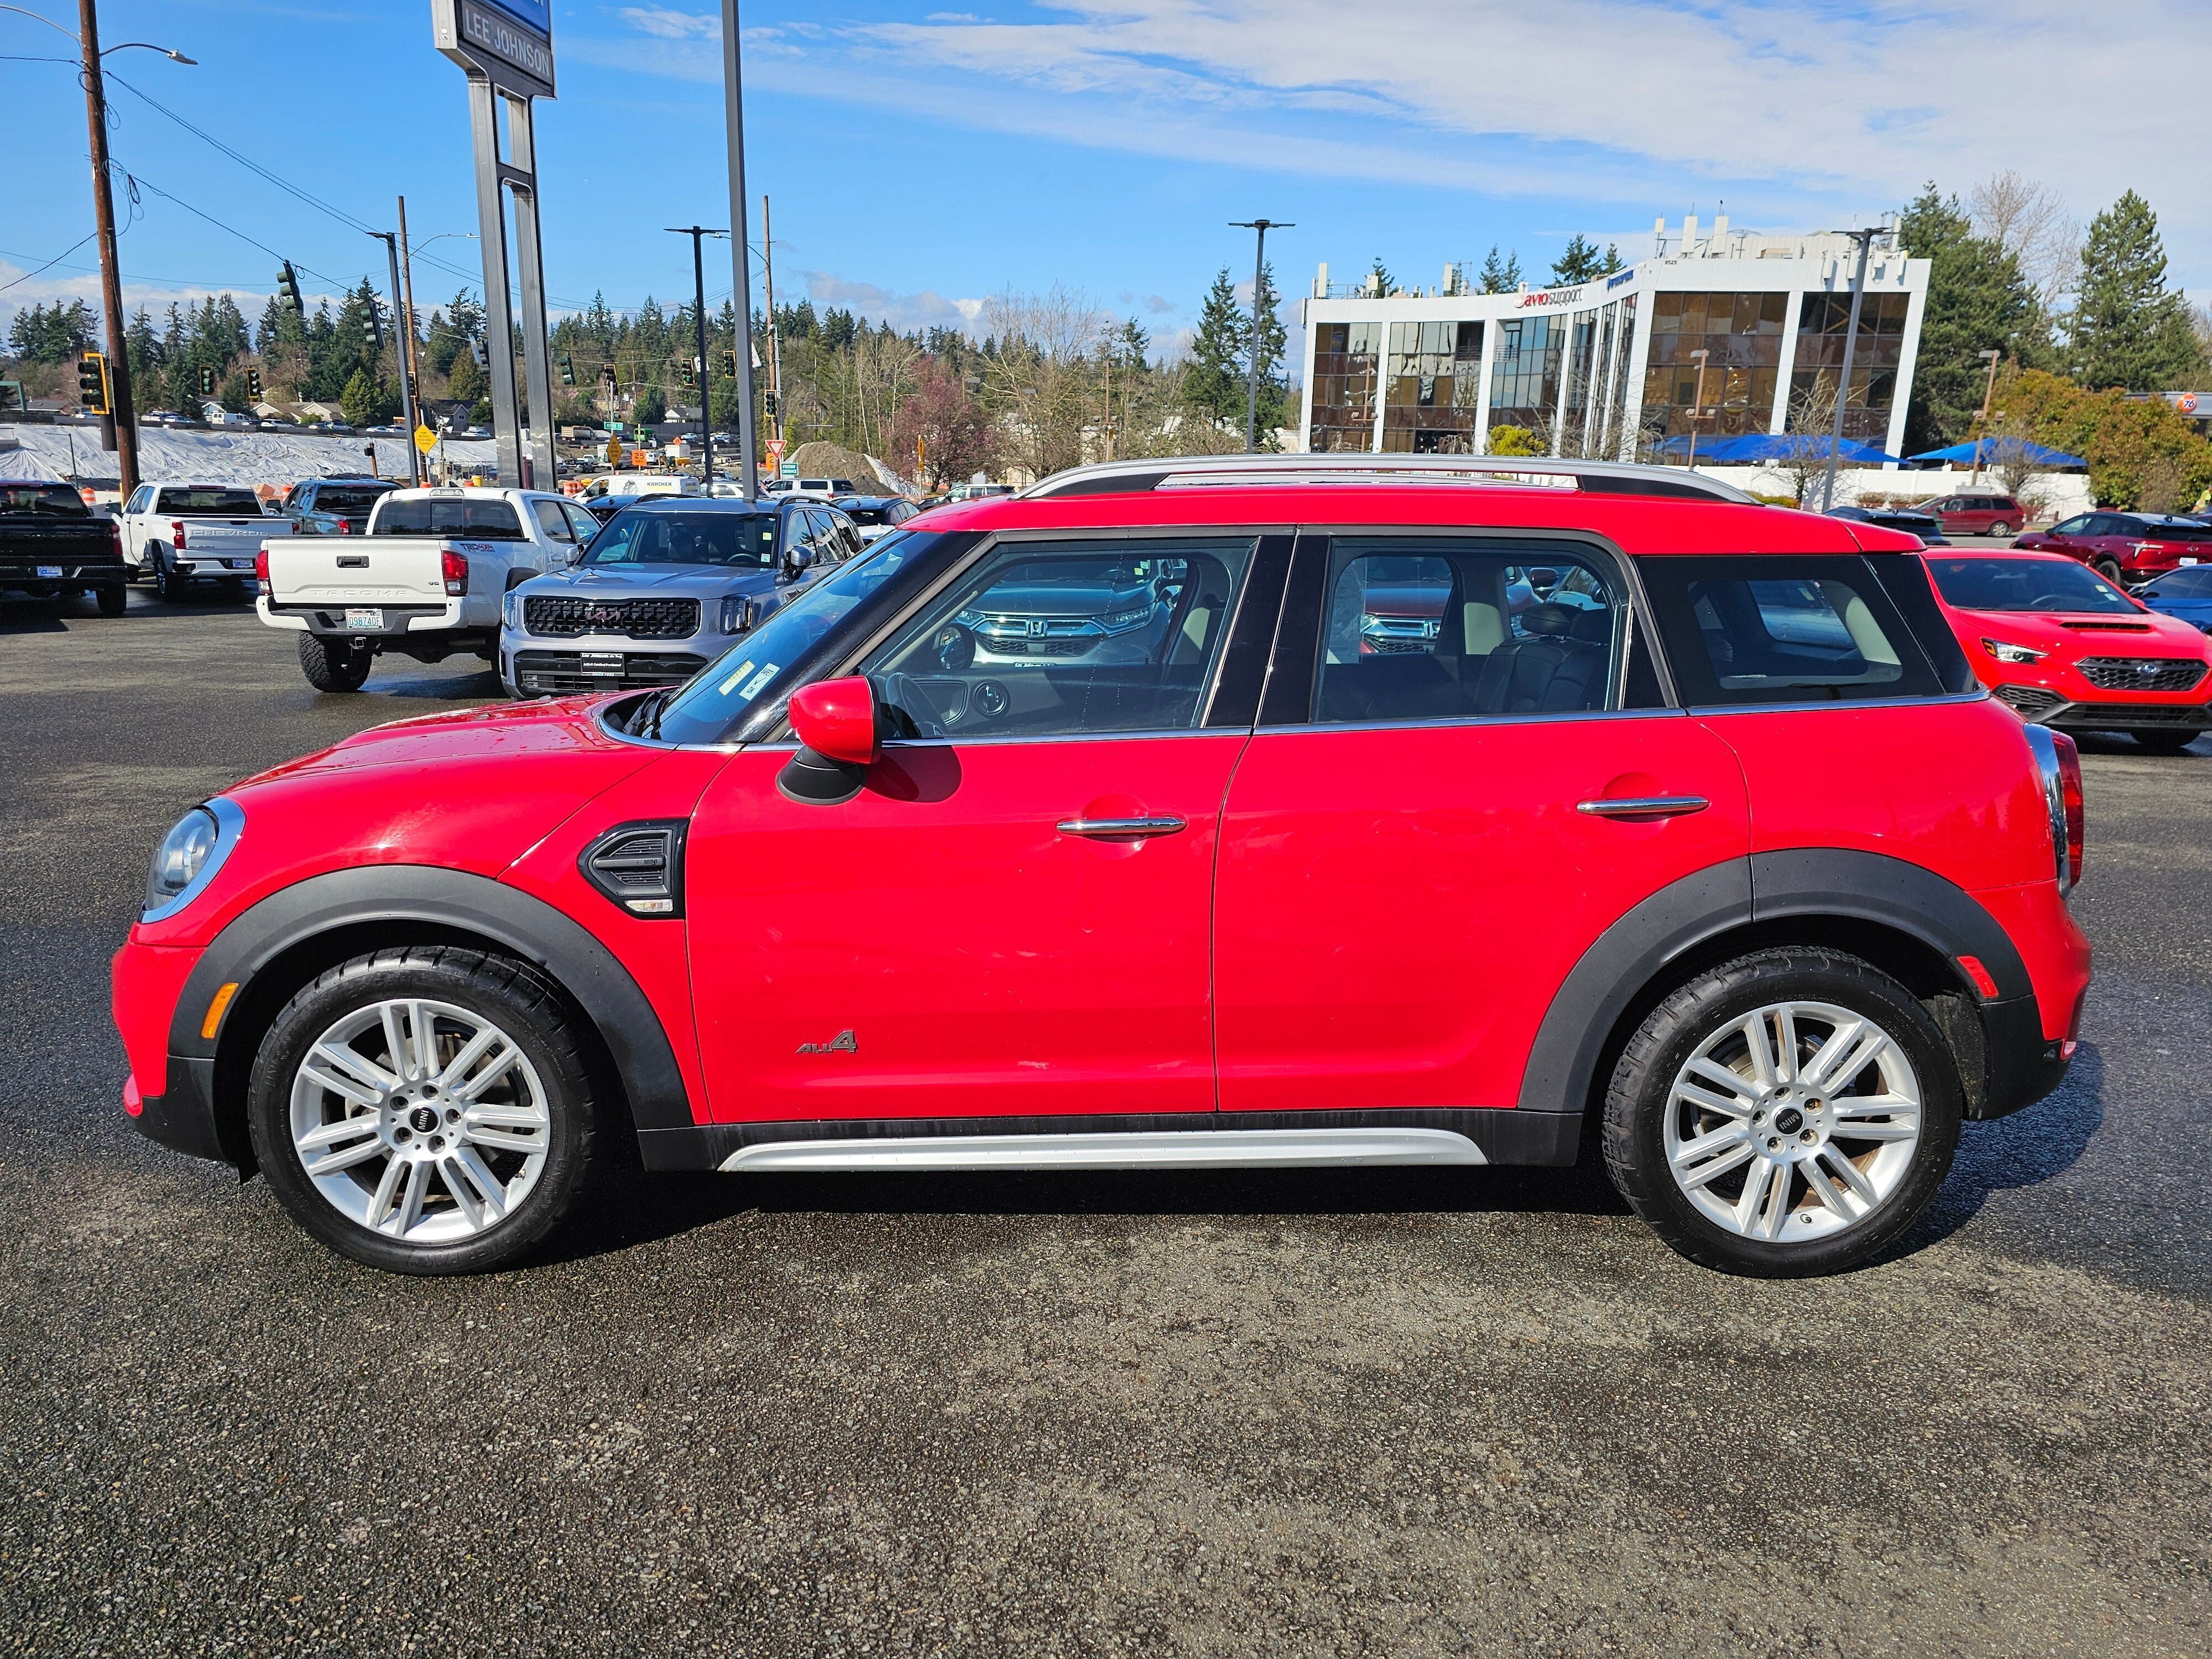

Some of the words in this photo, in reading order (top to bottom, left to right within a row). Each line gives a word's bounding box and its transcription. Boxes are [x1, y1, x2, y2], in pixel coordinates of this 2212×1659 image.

[465, 8, 491, 44] LEE
[494, 27, 550, 77] JOHNSON
[796, 1030, 857, 1053] ALL4
[418, 1109, 429, 1130] MINI
[1779, 1113, 1800, 1130] MINI
